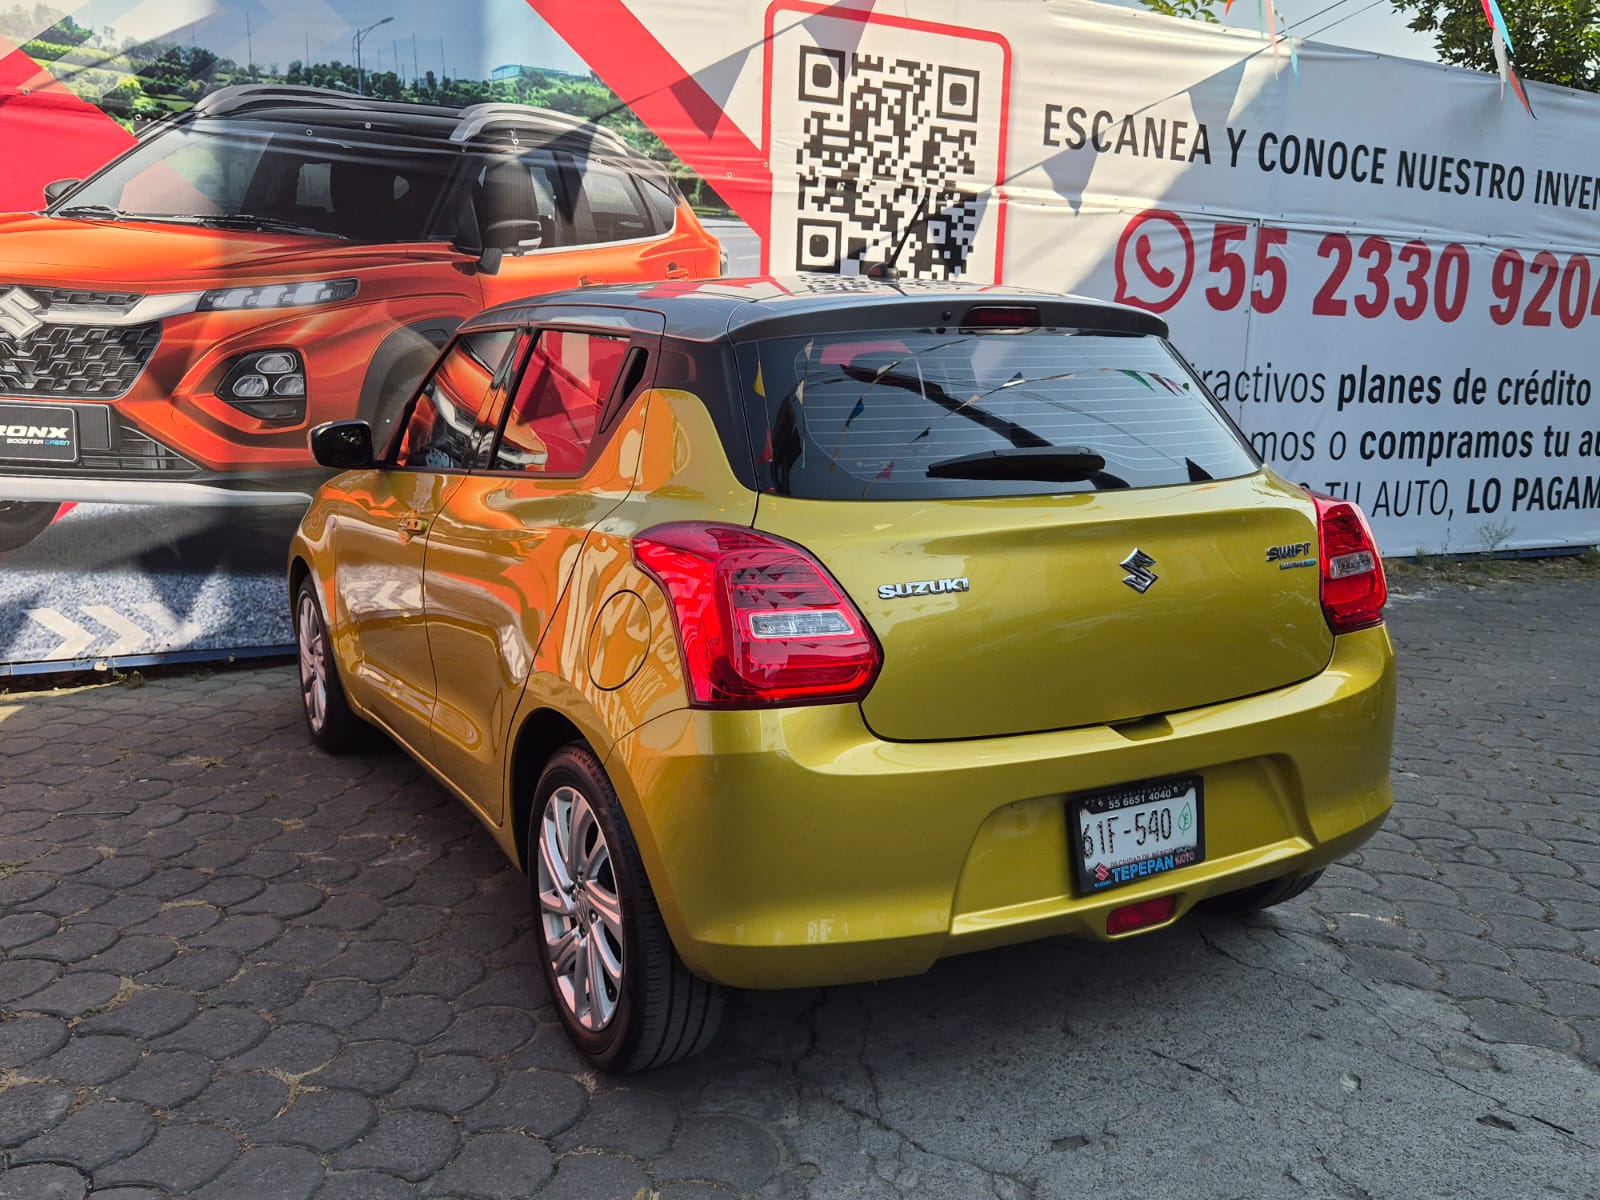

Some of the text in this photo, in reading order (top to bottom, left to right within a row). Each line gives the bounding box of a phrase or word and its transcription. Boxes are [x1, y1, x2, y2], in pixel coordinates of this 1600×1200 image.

[1043, 103, 1211, 165] ESCANEA
[1226, 127, 1247, 168] Y
[1258, 132, 1387, 185] CONOCE
[1396, 150, 1525, 202] NUESTRO
[1205, 223, 1288, 314] 55
[1312, 233, 1470, 323] 2330
[1337, 364, 1442, 412] planes
[1453, 367, 1487, 405] de
[1497, 369, 1592, 406] crédito
[1329, 430, 1347, 461] o
[1359, 430, 1534, 467] compramos
[1544, 425, 1570, 457] tu
[1371, 479, 1454, 521] AUTO,
[1466, 477, 1501, 514] LO
[1265, 541, 1312, 562] SWIFT
[878, 577, 970, 600] SUZUKI
[1108, 799, 1121, 809] 55
[1148, 789, 1172, 801] 4040
[1081, 807, 1172, 859] 61F-540
[1111, 854, 1175, 882] TEPEPAN
